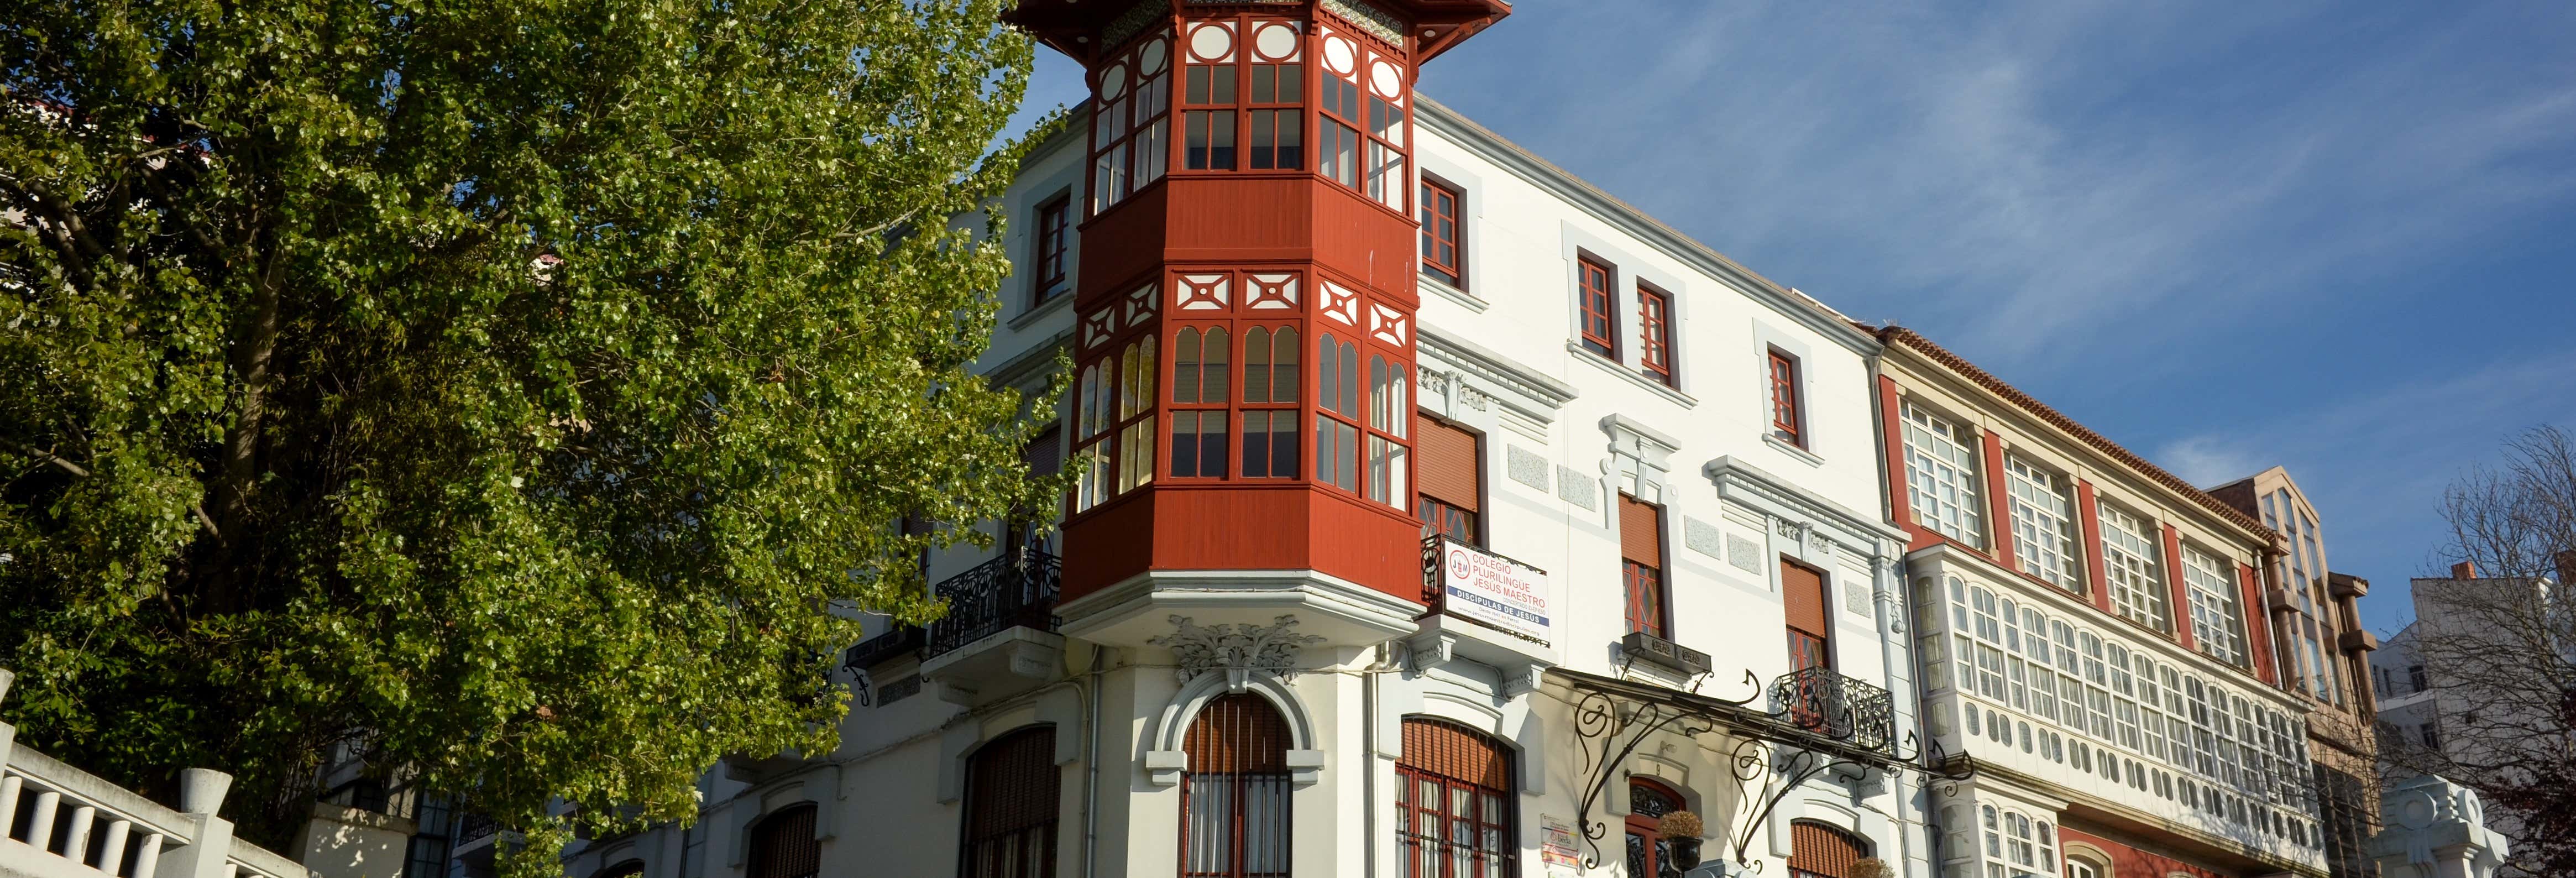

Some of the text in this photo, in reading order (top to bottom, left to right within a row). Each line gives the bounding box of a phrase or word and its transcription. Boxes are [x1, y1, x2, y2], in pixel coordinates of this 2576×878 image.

[1473, 554, 1511, 574] COLEGIO
[1473, 565, 1531, 593] PLURILINGÜE
[1473, 577, 1546, 608] JESÚS MAESTRO
[1457, 589, 1540, 623] DISCÍPULAS DE JESÚS
